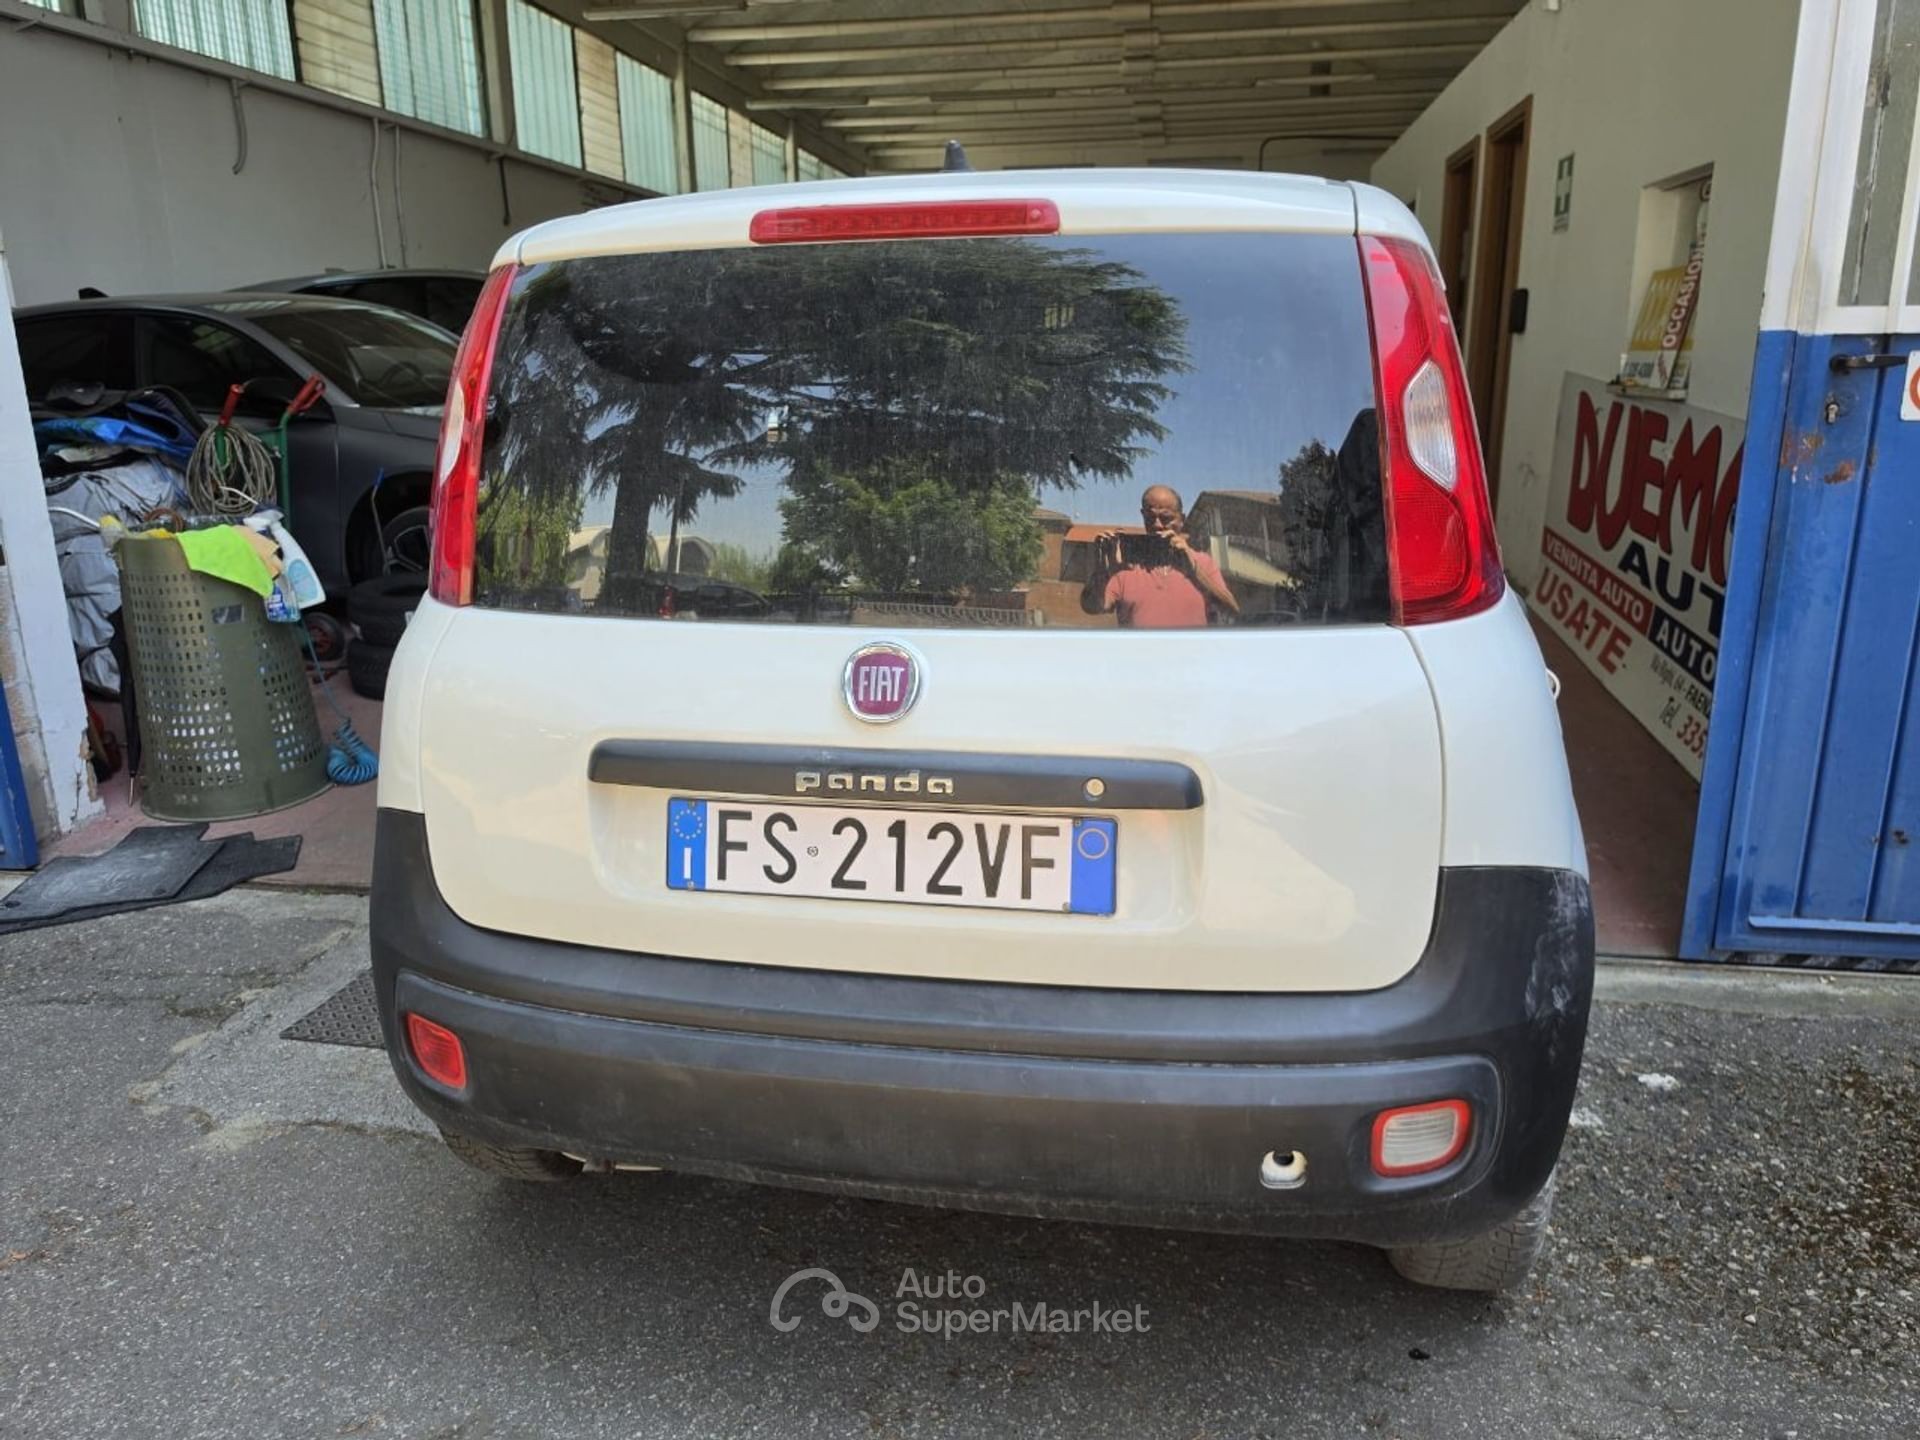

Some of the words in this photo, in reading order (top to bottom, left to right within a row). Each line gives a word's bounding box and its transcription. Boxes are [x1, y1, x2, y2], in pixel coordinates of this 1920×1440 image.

[1535, 567, 1633, 675] USATE
[1545, 534, 1599, 588] VENDITA
[1603, 578, 1645, 623] AUTO
[857, 665, 905, 702] FIAT
[795, 770, 955, 795] panda
[717, 809, 799, 884] FS
[831, 817, 1061, 900] 212VF
